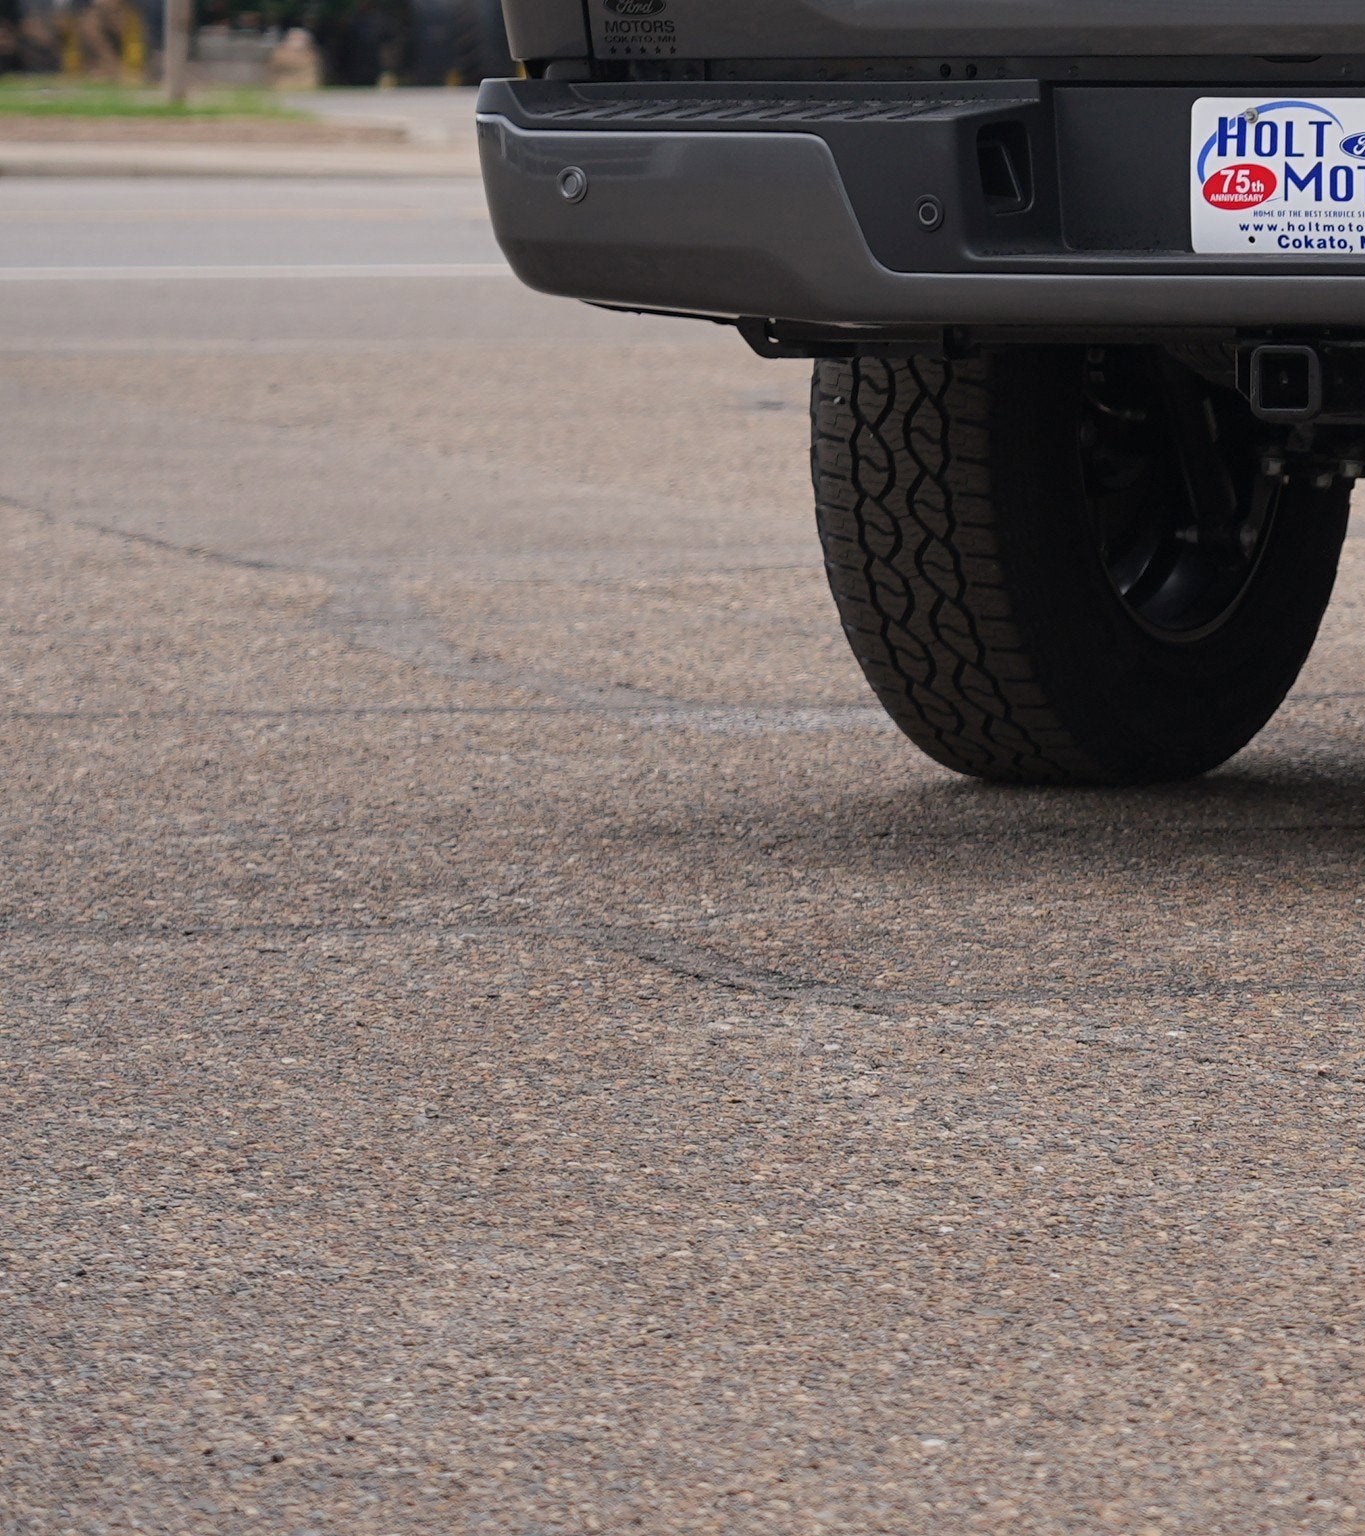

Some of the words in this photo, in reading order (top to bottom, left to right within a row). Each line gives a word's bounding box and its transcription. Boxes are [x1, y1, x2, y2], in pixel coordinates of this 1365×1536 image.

[604, 20, 676, 33] MOTORS
[1217, 117, 1333, 157] HOLT
[1220, 169, 1265, 194] 75th
[1210, 193, 1264, 204] ANNIVERSARY
[1277, 234, 1354, 252] Cokato,
